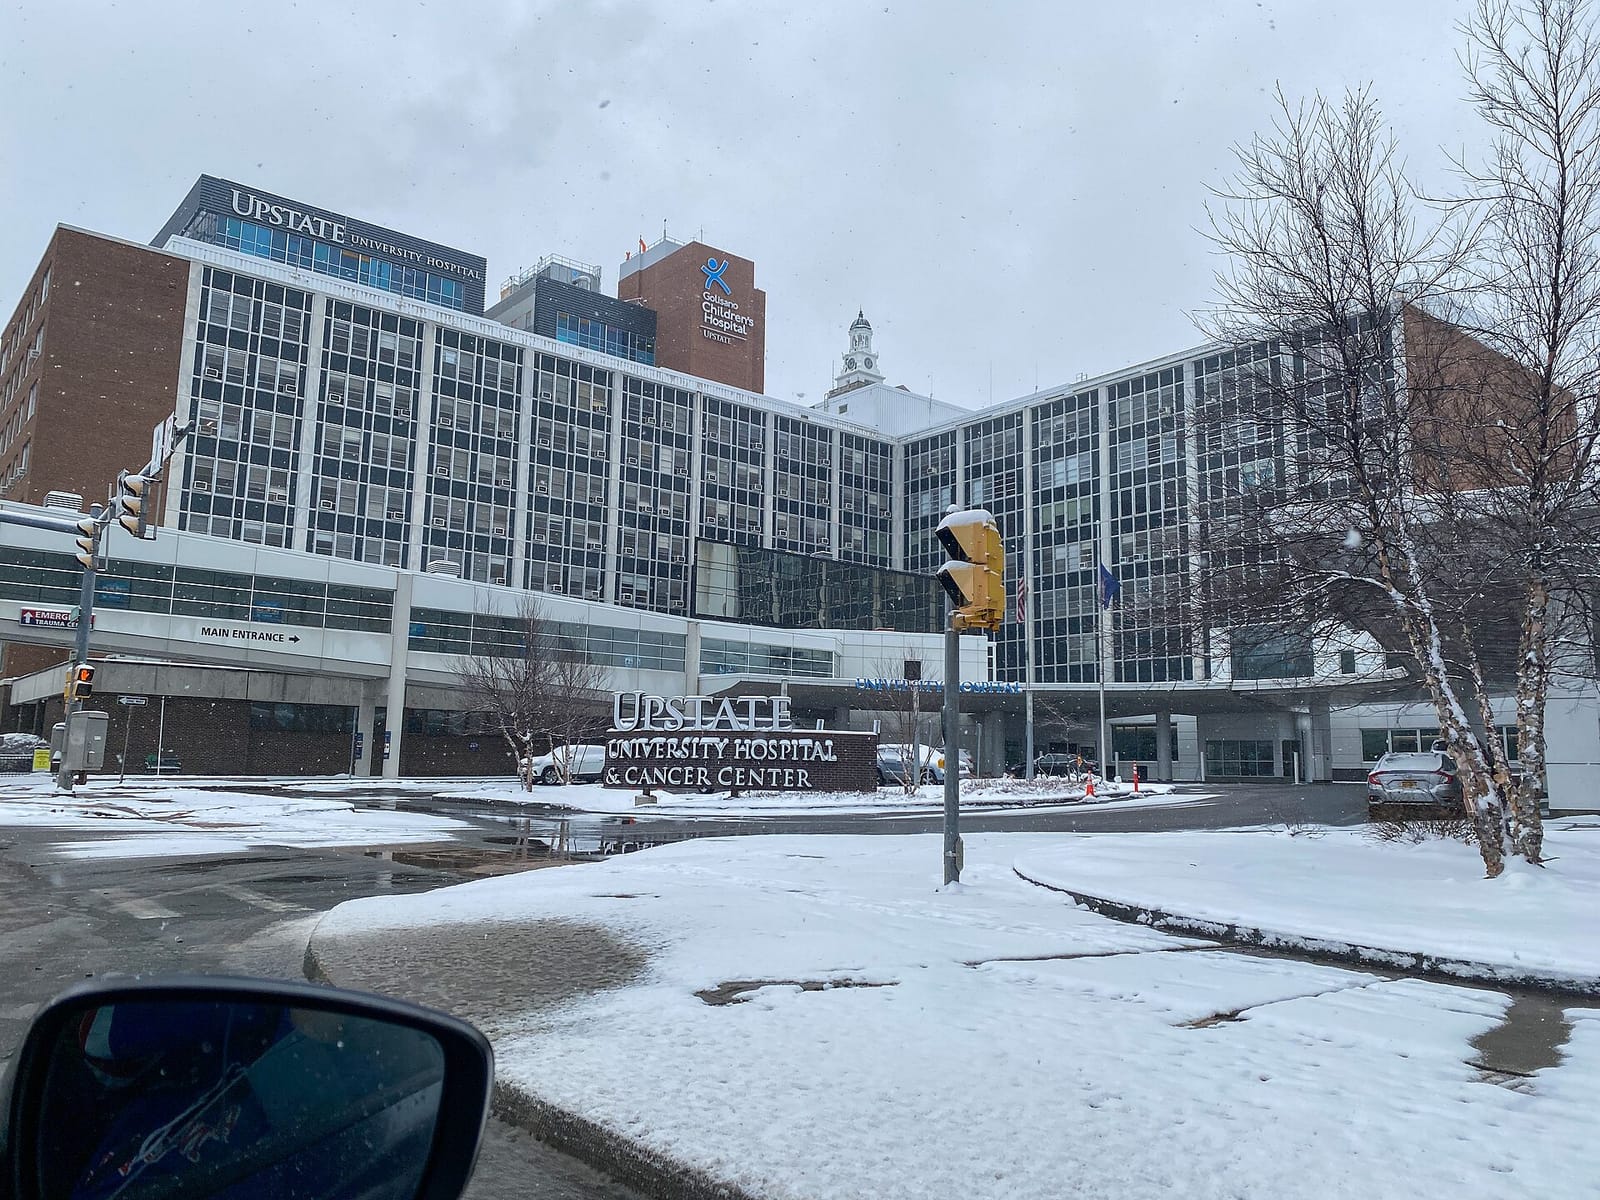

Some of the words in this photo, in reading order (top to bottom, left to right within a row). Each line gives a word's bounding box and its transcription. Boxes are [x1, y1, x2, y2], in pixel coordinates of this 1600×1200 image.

[230, 188, 345, 243] UPSTATE
[350, 234, 423, 262] UNIVERSITY
[426, 256, 483, 280] HOSPITAL
[703, 291, 738, 309] Golisano
[702, 302, 754, 327] Children's
[704, 312, 747, 335] Hospital
[703, 329, 732, 345] UPSTATE
[35, 611, 72, 621] EMERG
[35, 619, 65, 627] TRAUMA
[201, 627, 230, 638] MAIN
[232, 629, 285, 642] ENTRANCE
[959, 680, 1022, 695] OSPITAL
[613, 691, 793, 732] UPSTATE
[607, 737, 729, 760] UNIVERSITY
[734, 738, 838, 762] HOSPITAL
[605, 767, 620, 785] &
[624, 766, 712, 786] CANCER
[717, 766, 813, 788] CENTER
